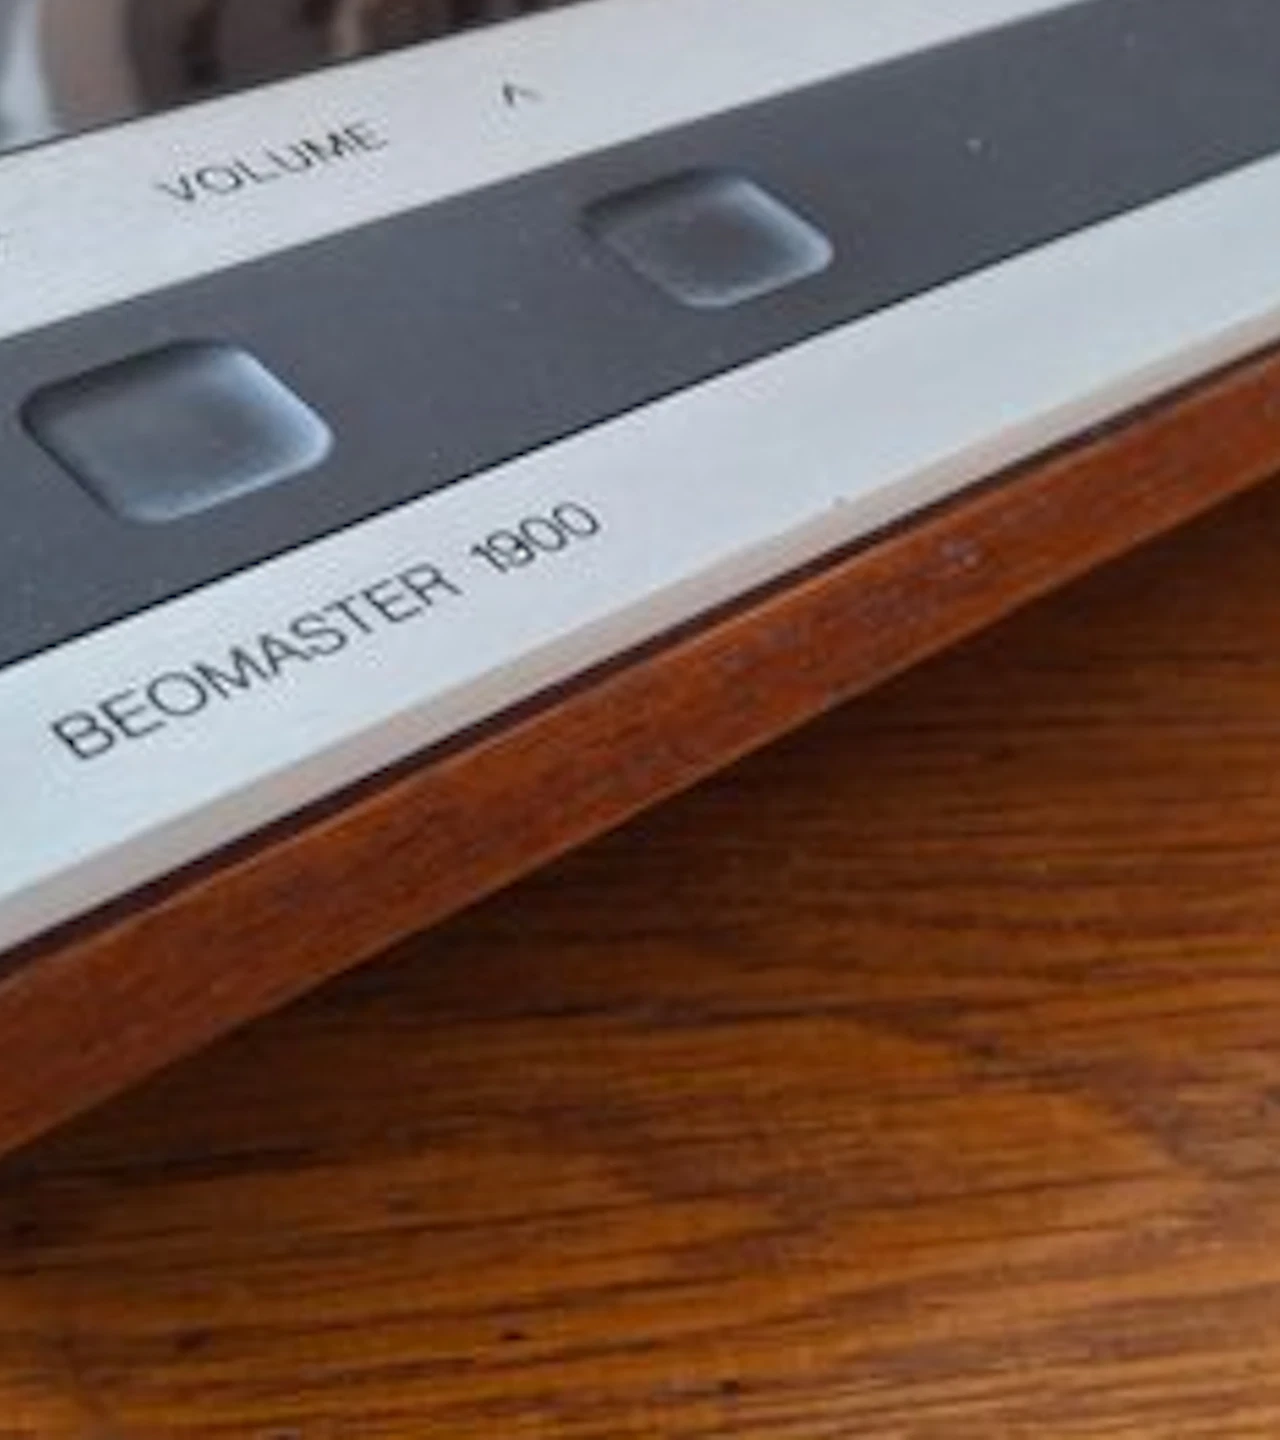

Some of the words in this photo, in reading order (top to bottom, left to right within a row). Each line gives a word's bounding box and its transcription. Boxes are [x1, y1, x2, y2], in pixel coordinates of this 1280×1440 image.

[155, 122, 389, 202] VOLUME
[51, 561, 463, 761] BEOMASTER
[469, 501, 601, 575] 1900
